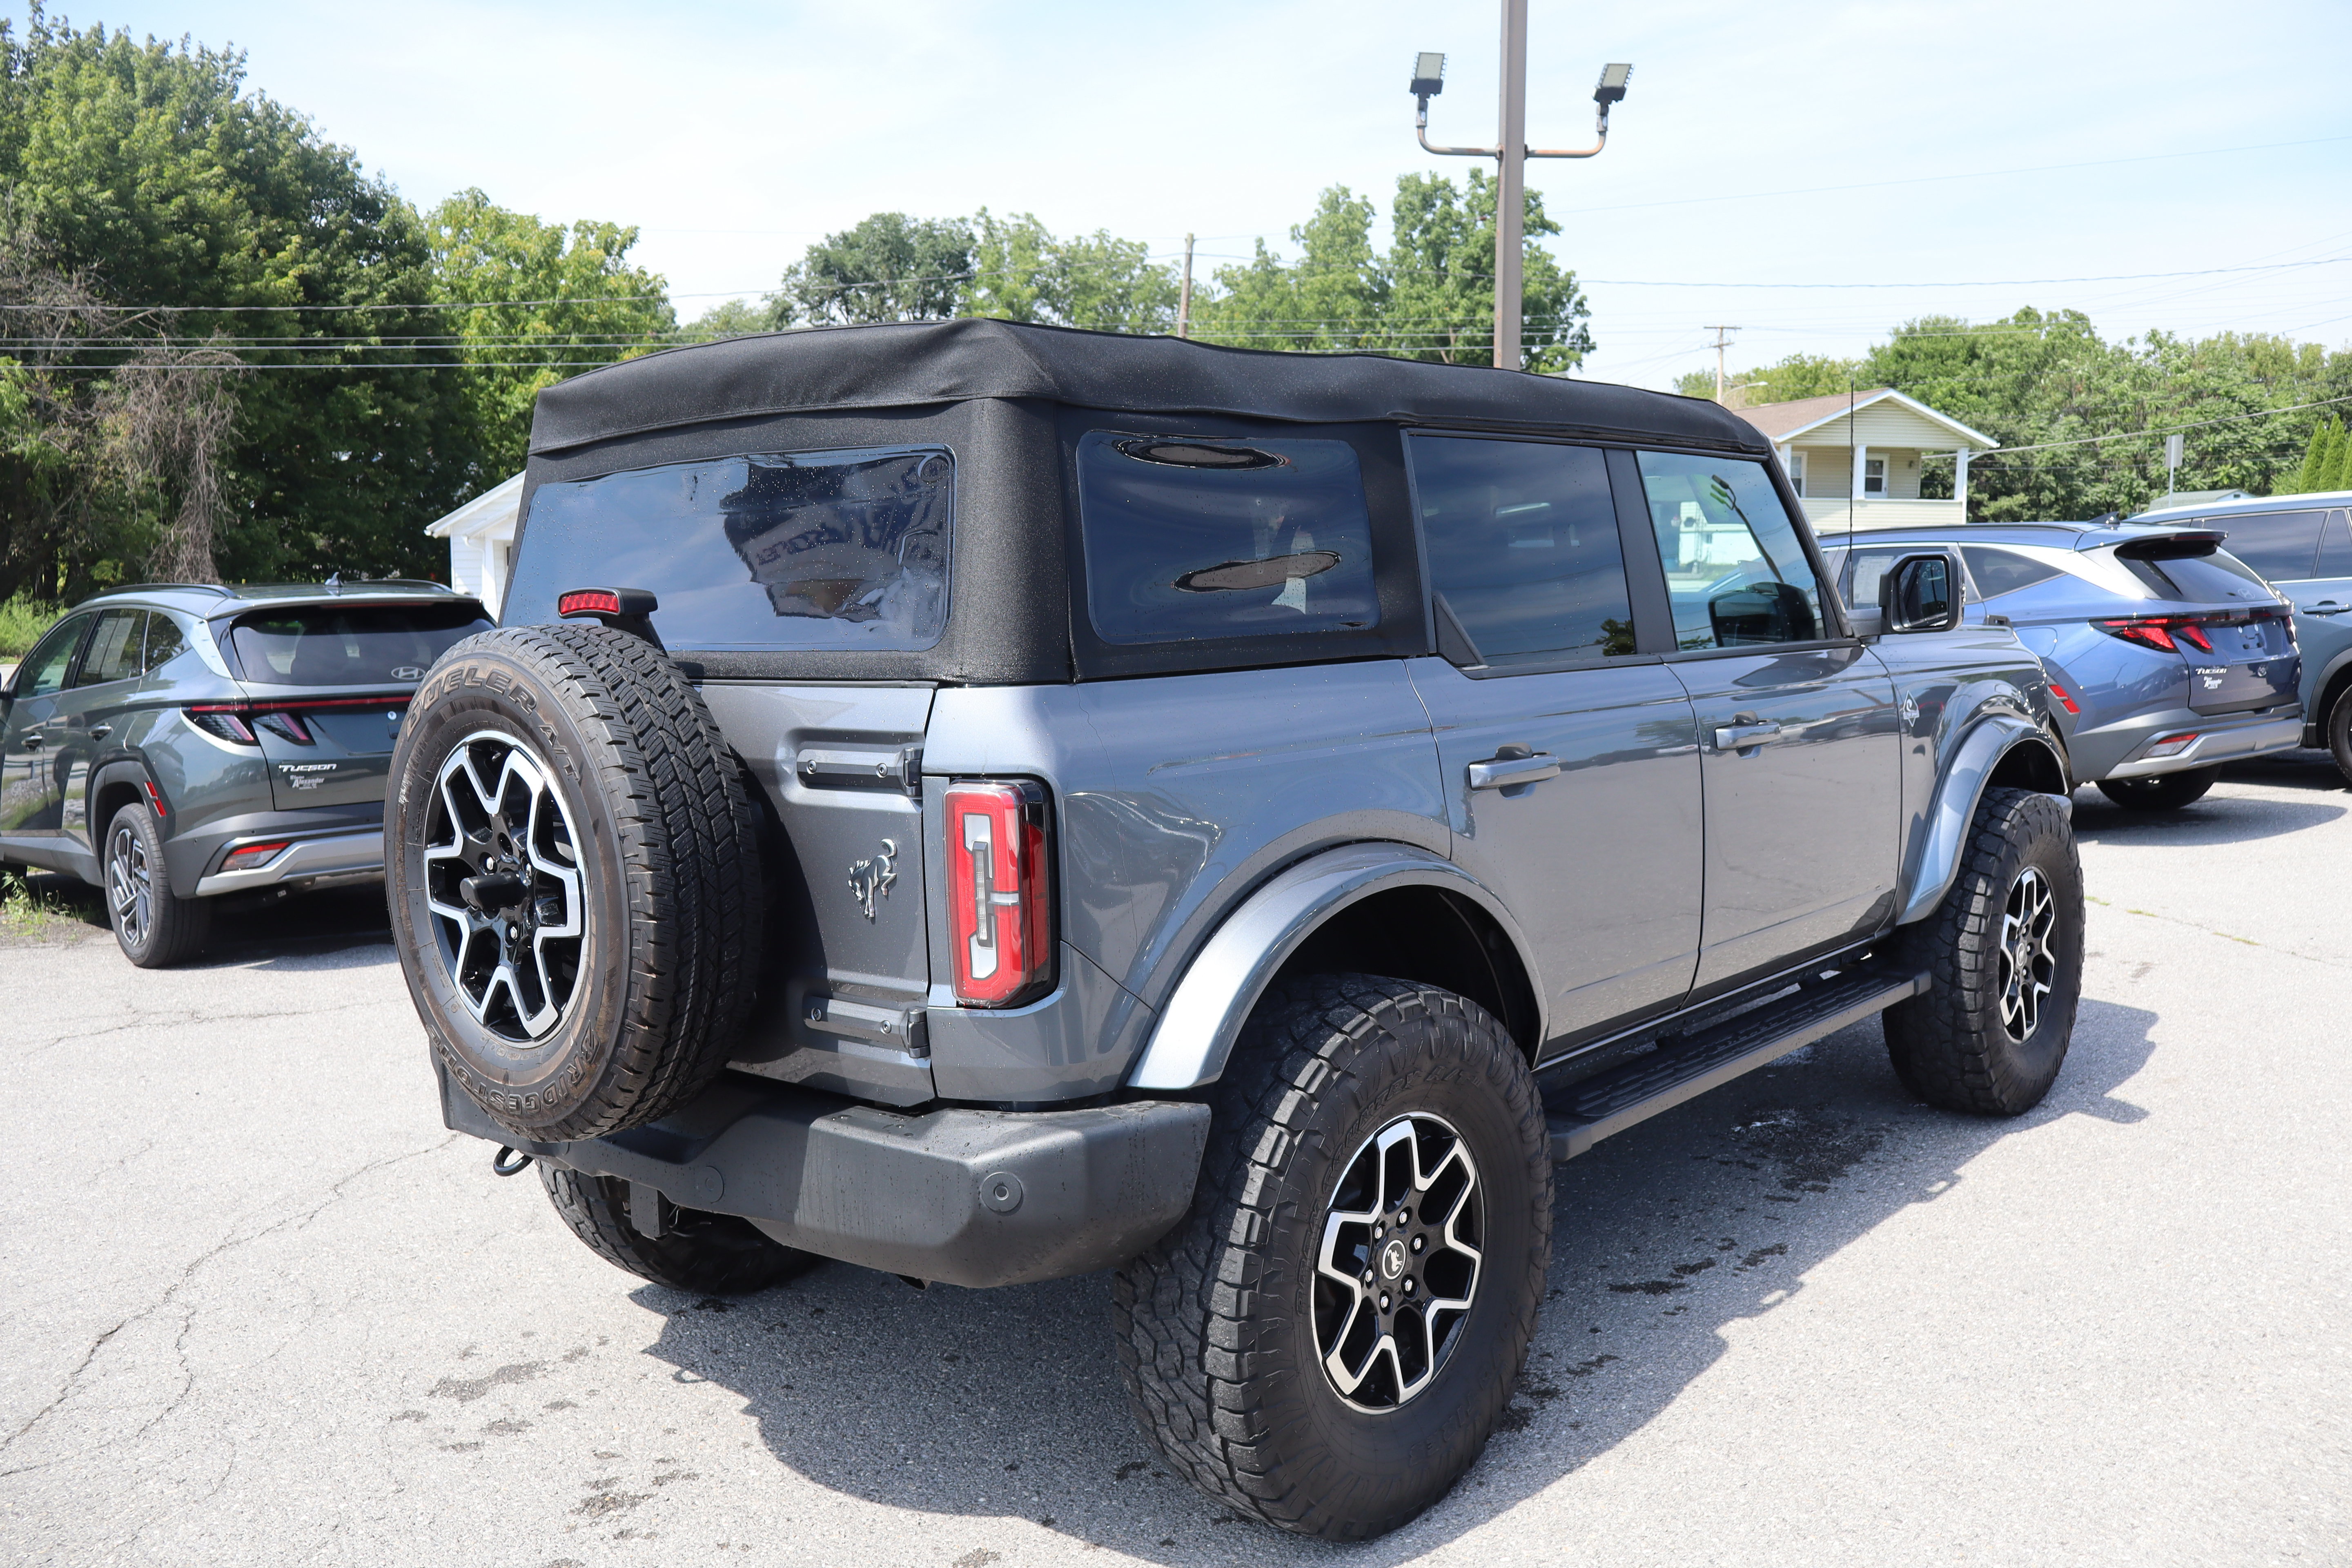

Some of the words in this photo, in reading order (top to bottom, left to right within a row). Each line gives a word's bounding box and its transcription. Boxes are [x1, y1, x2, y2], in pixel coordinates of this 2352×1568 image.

[407, 665, 538, 737] DUELER
[539, 723, 583, 786] A/T
[426, 1019, 601, 1115] BRIDGESTONE
